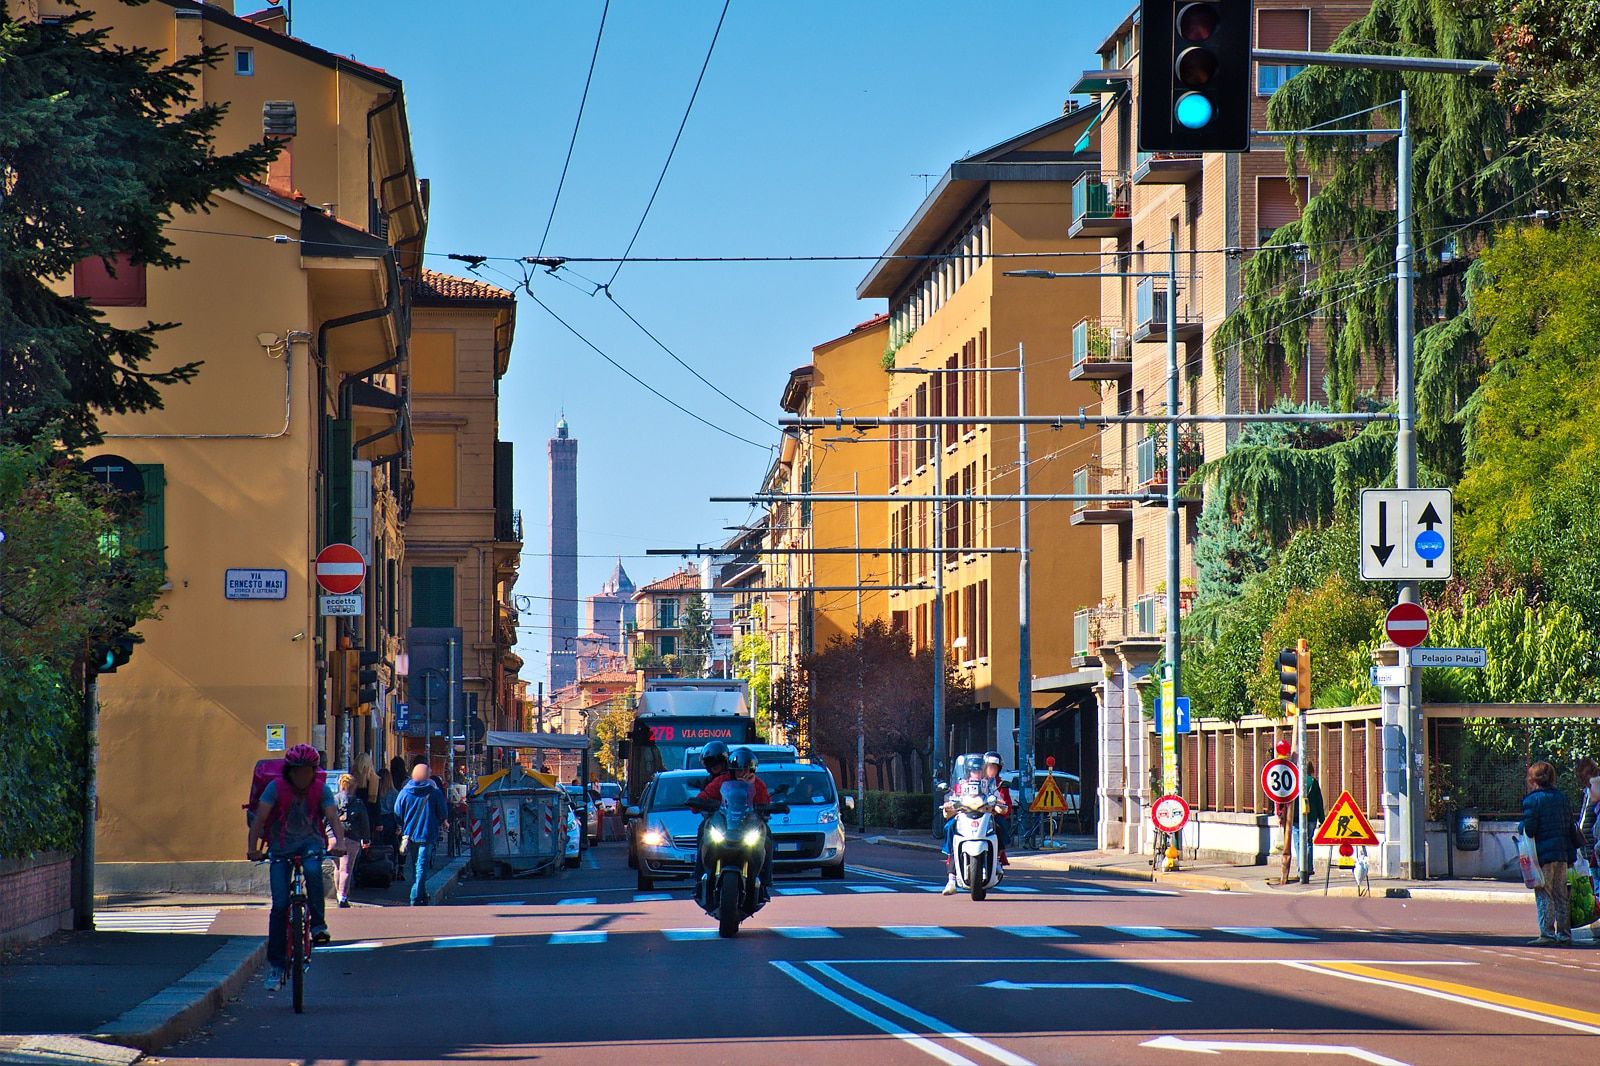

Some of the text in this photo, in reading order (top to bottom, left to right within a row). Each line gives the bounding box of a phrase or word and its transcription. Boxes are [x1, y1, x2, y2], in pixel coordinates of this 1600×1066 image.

[230, 580, 282, 588] ERNESTO MASI
[1422, 654, 1481, 663] Pelagio Palagi
[400, 706, 408, 719] F
[649, 726, 732, 740] 27B VIA GENOVA
[1271, 770, 1292, 791] 30
